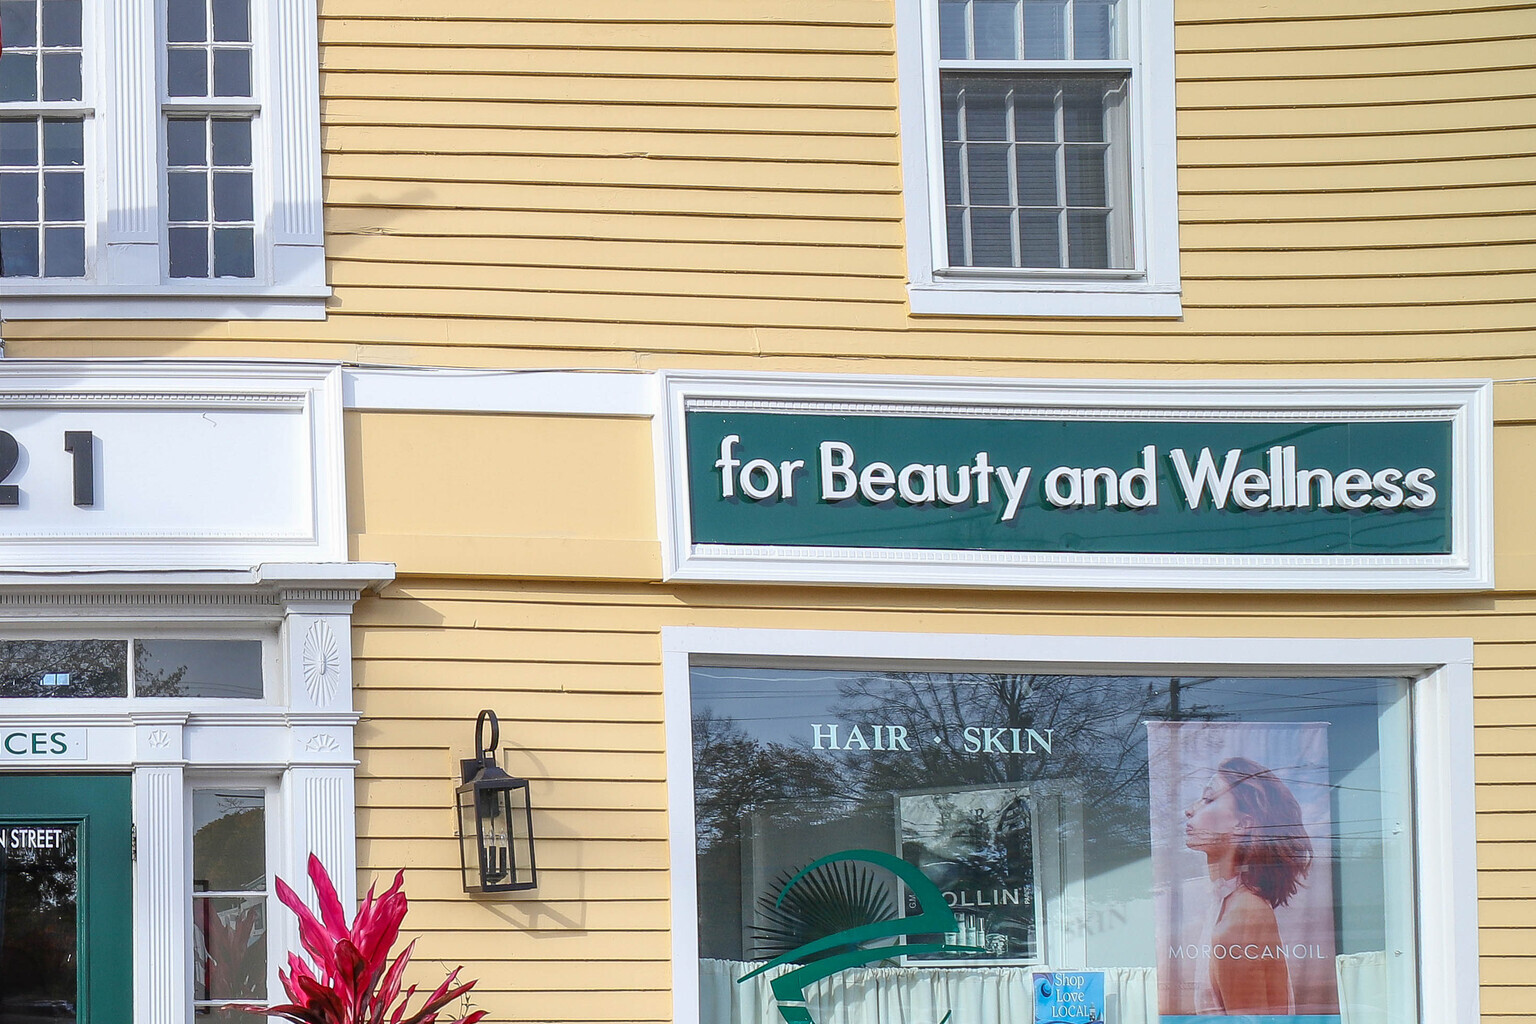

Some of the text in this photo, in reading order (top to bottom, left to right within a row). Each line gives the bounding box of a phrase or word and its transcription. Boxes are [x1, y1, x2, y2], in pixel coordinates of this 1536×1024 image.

[715, 434, 1436, 521] for Beauty and Wellness
[811, 723, 1054, 754] HAIR SKIN
[10, 829, 62, 848] STREET
[941, 888, 1020, 907] OLLIN
[1168, 944, 1326, 960] MOROCCANOIL
[1054, 973, 1085, 990] Shop
[1056, 989, 1085, 1002] Love
[1051, 1005, 1090, 1018] LOCAL
